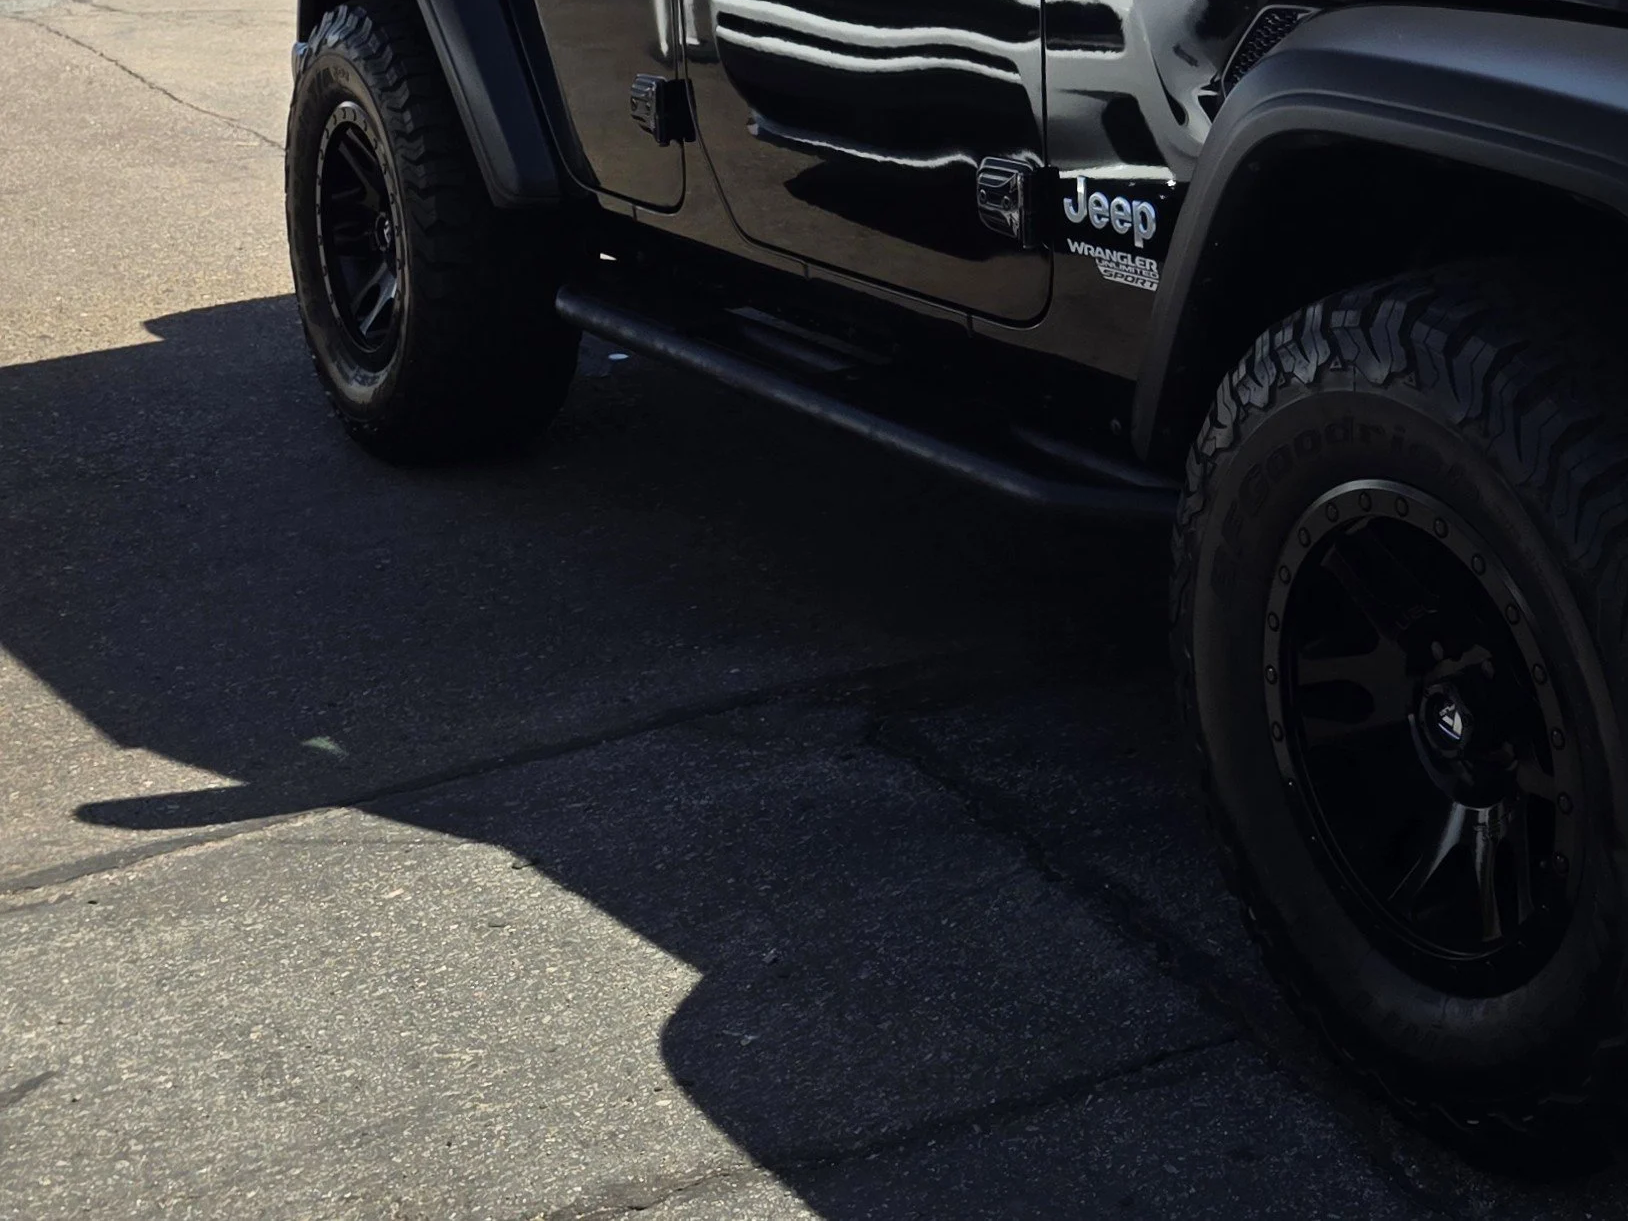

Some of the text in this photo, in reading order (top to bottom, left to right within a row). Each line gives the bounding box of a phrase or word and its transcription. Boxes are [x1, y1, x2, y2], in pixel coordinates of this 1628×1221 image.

[1063, 175, 1156, 249] Jeep
[1066, 237, 1158, 273] WRANGLER
[1095, 257, 1159, 279] UNLIMITED
[1101, 268, 1159, 290] SPORT
